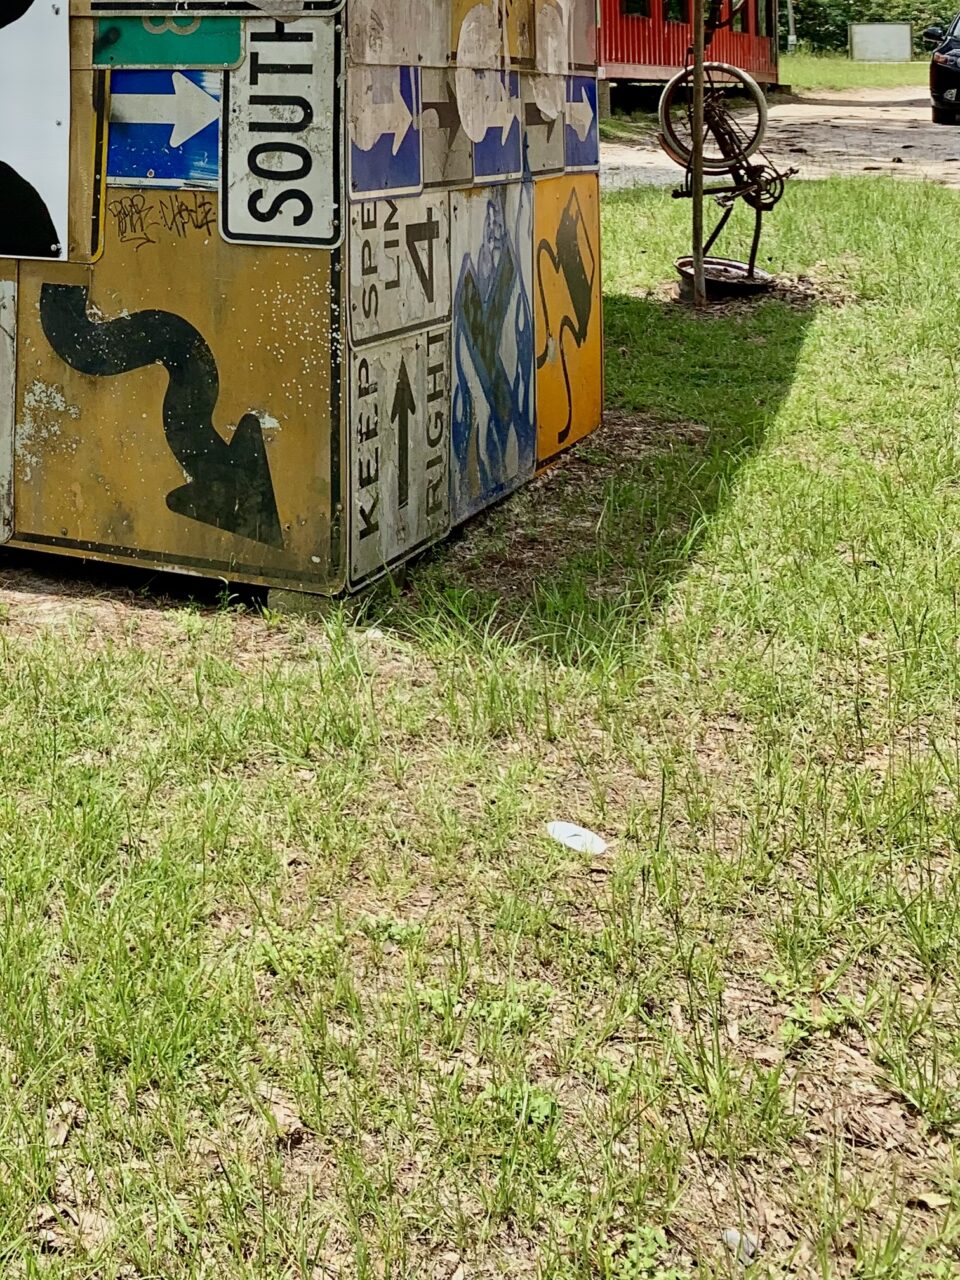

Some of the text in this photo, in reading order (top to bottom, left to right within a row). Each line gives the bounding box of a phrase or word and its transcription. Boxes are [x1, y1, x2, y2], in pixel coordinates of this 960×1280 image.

[248, 21, 314, 227] SOUTH
[358, 358, 379, 541] KEEP
[426, 331, 444, 516] RIGHT
